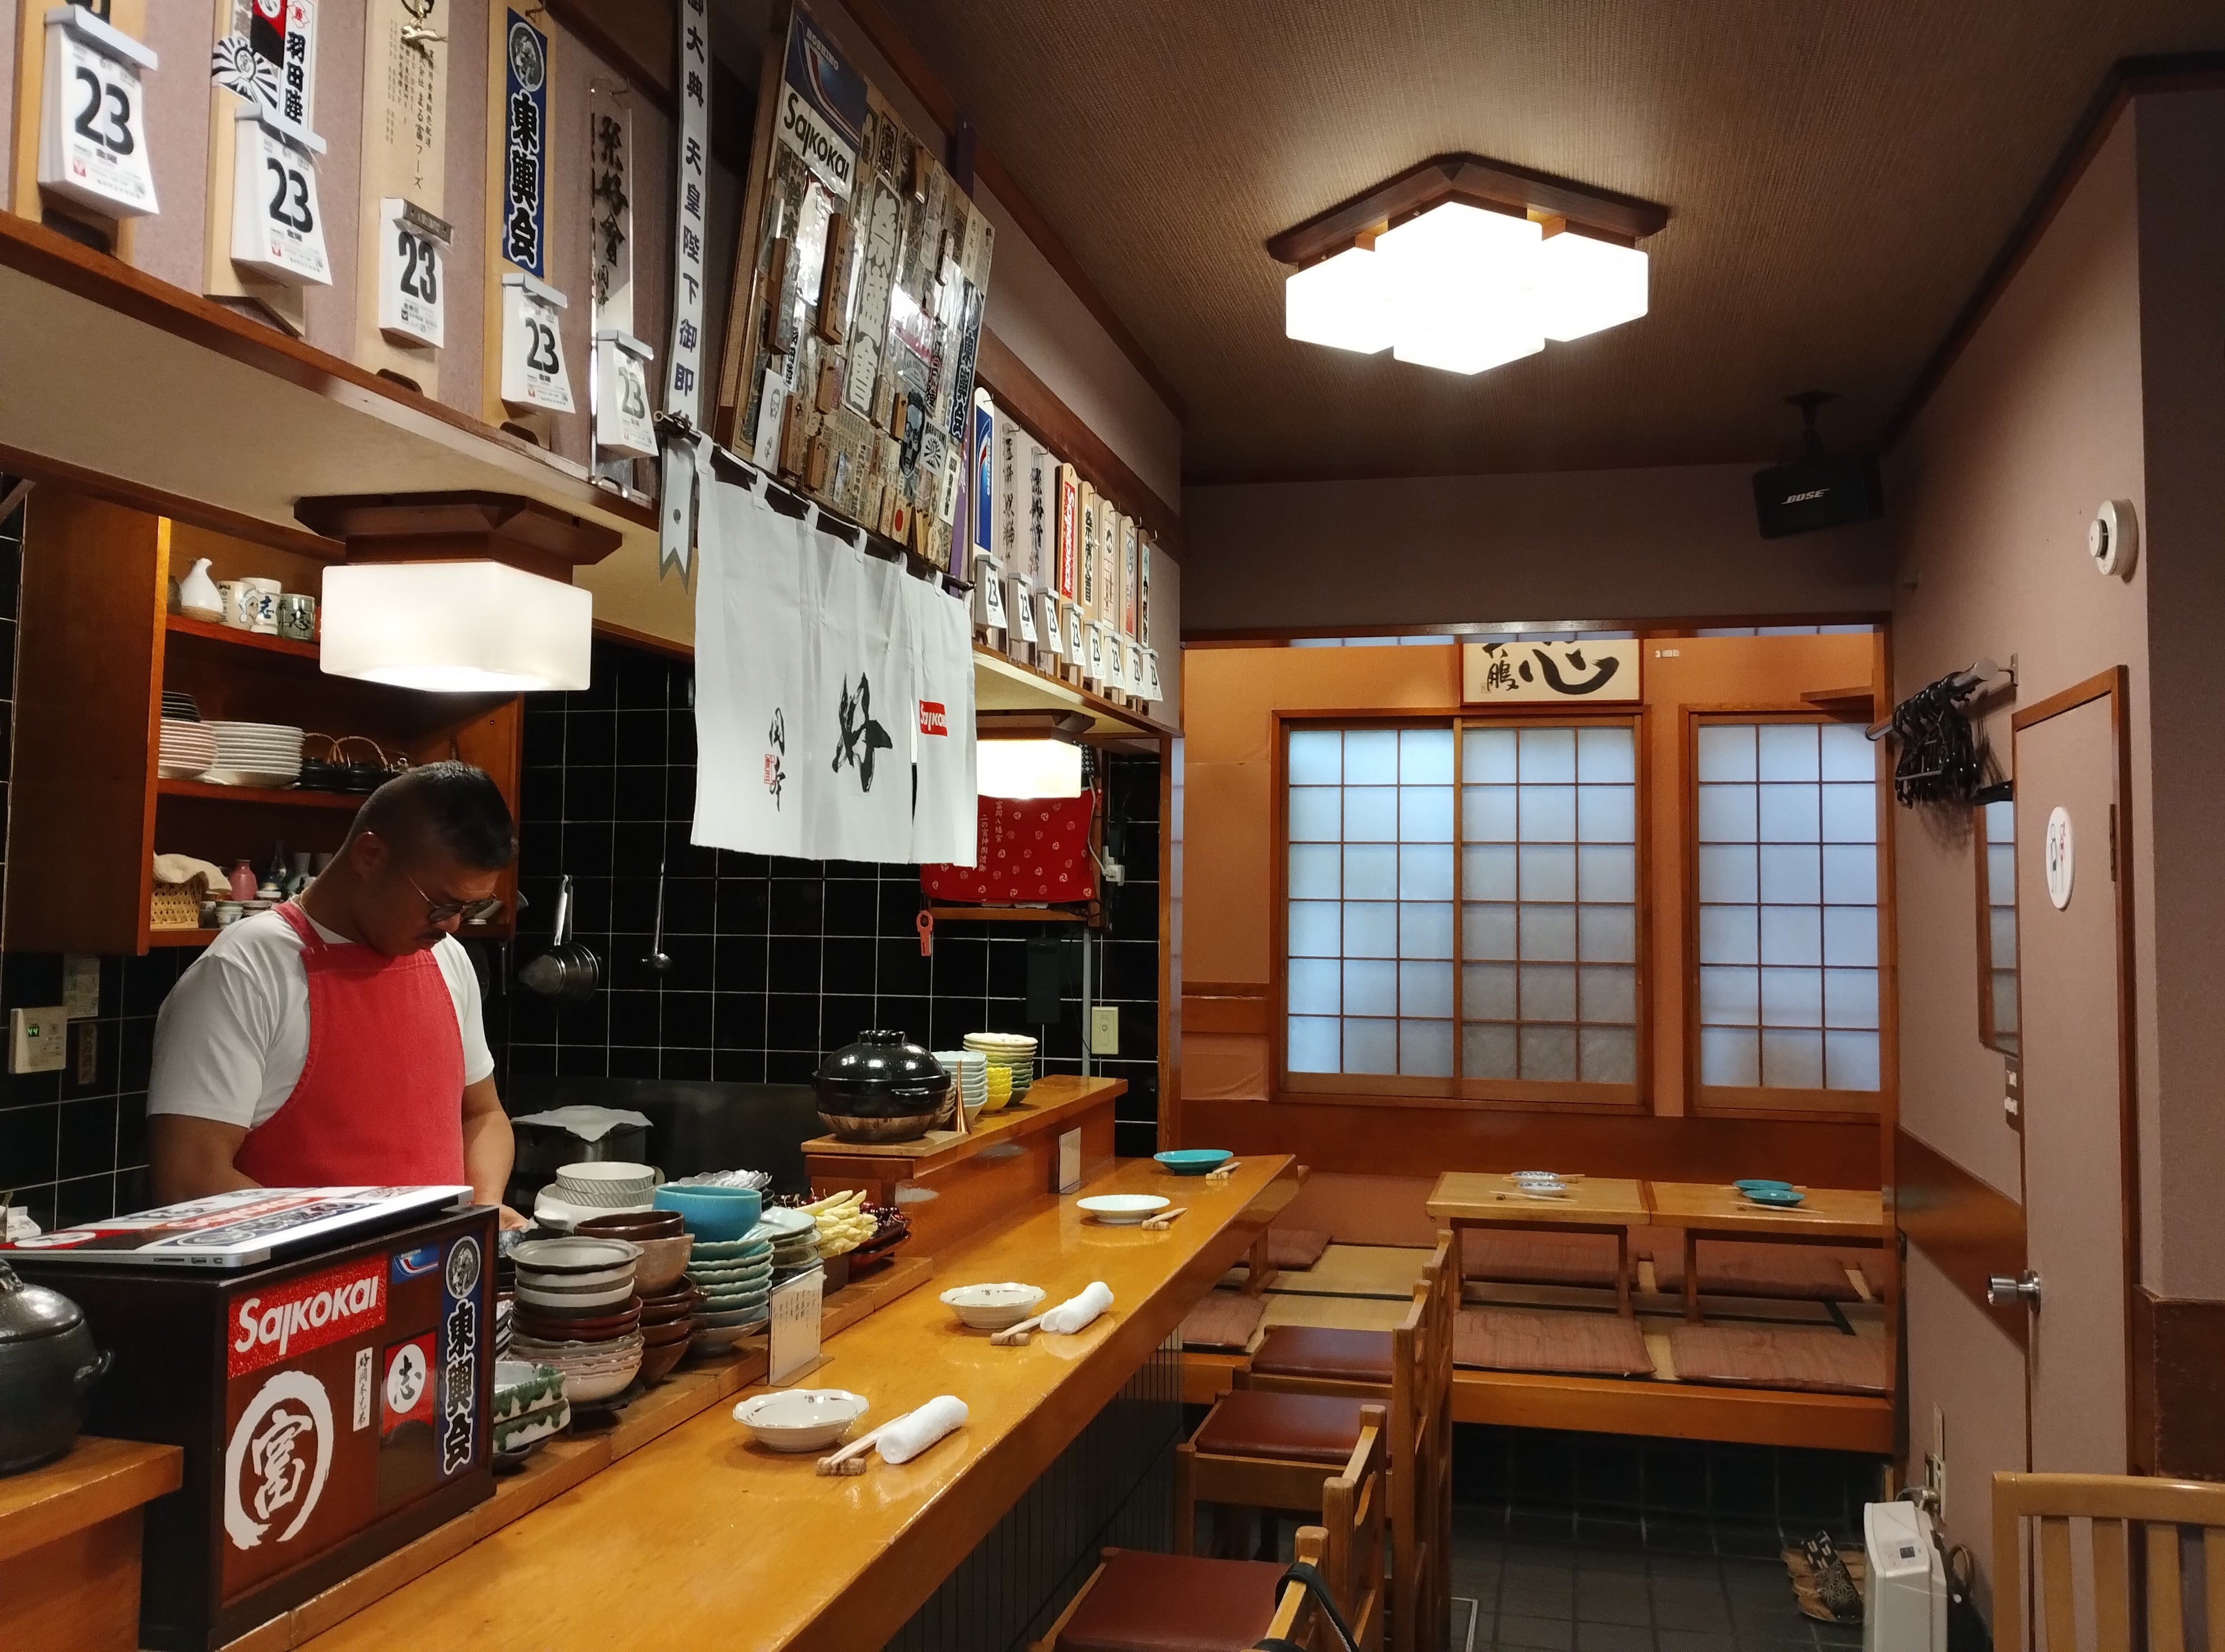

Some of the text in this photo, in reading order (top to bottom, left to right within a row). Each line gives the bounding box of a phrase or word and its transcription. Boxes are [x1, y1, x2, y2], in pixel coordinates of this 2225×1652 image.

[75, 65, 135, 155] 23
[267, 157, 313, 233] 23
[399, 231, 437, 305] 23
[526, 317, 559, 375] 23
[619, 366, 645, 419] 23
[1781, 488, 1829, 504] BOSE
[988, 577, 999, 607] 23
[1020, 594, 1029, 622] 23
[1047, 606, 1056, 633] 23
[1072, 622, 1080, 648] 23
[1093, 638, 1100, 662] 23
[1112, 648, 1120, 672] 23
[1134, 659, 1140, 682] 23
[1150, 664, 1157, 686] 23
